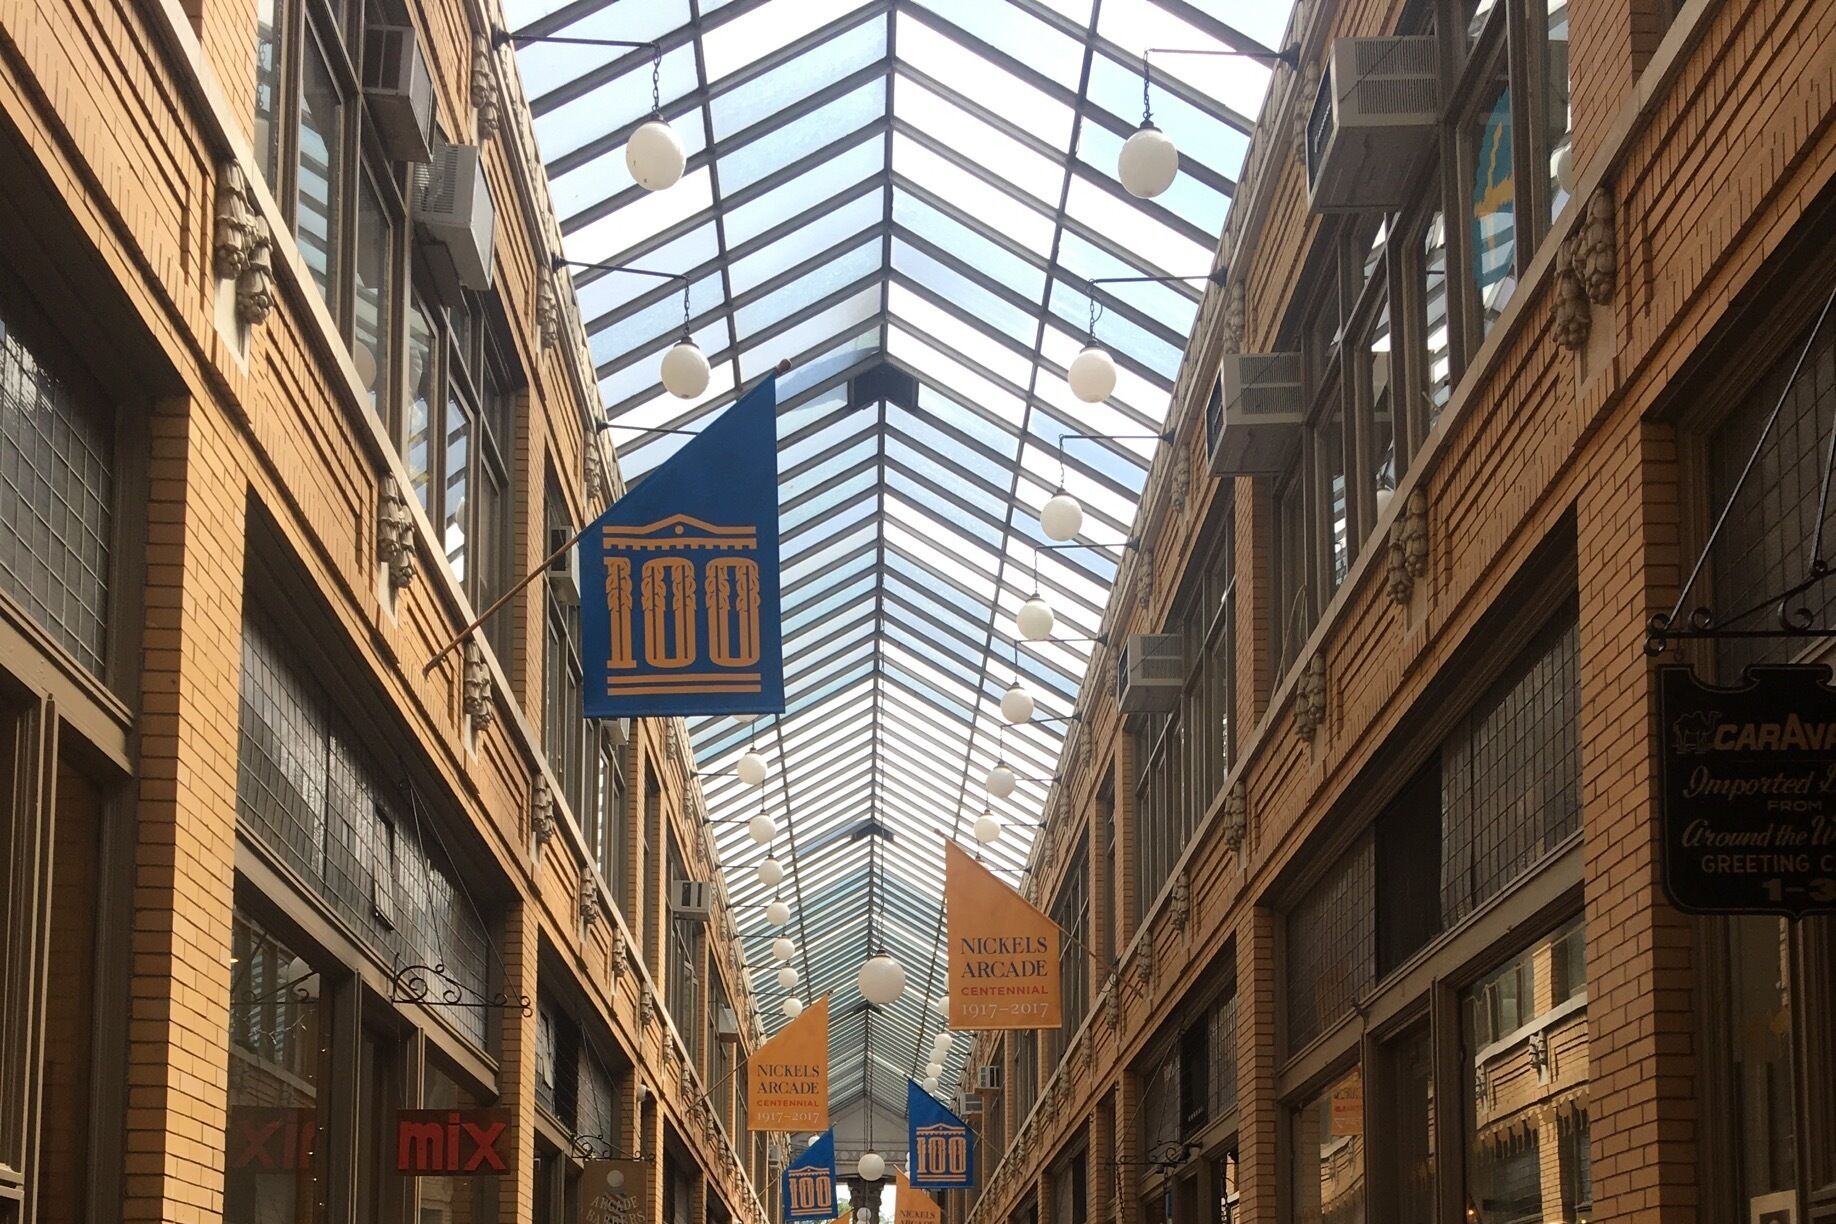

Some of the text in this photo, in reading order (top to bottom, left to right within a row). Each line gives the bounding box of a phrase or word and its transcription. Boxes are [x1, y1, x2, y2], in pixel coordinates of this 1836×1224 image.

[603, 556, 761, 669] 100
[1682, 764, 1814, 800] Imported
[1767, 800, 1822, 812] FROM
[1681, 818, 1774, 848] Around
[1775, 823, 1809, 848] the
[1701, 854, 1810, 874] GREETING
[961, 936, 1048, 954] NICKELS
[962, 960, 1048, 978] ARCADE
[961, 984, 1049, 996] CENTENNIAL
[757, 1064, 819, 1077] NICKELS
[757, 1082, 819, 1094] ARCADE
[757, 1099, 819, 1107] CENTENNIAL
[397, 1113, 508, 1171] mix
[917, 1136, 967, 1175] 100
[788, 1175, 832, 1209] 100
[591, 1195, 640, 1213] ARCADE
[899, 1209, 935, 1220] NICKELS
